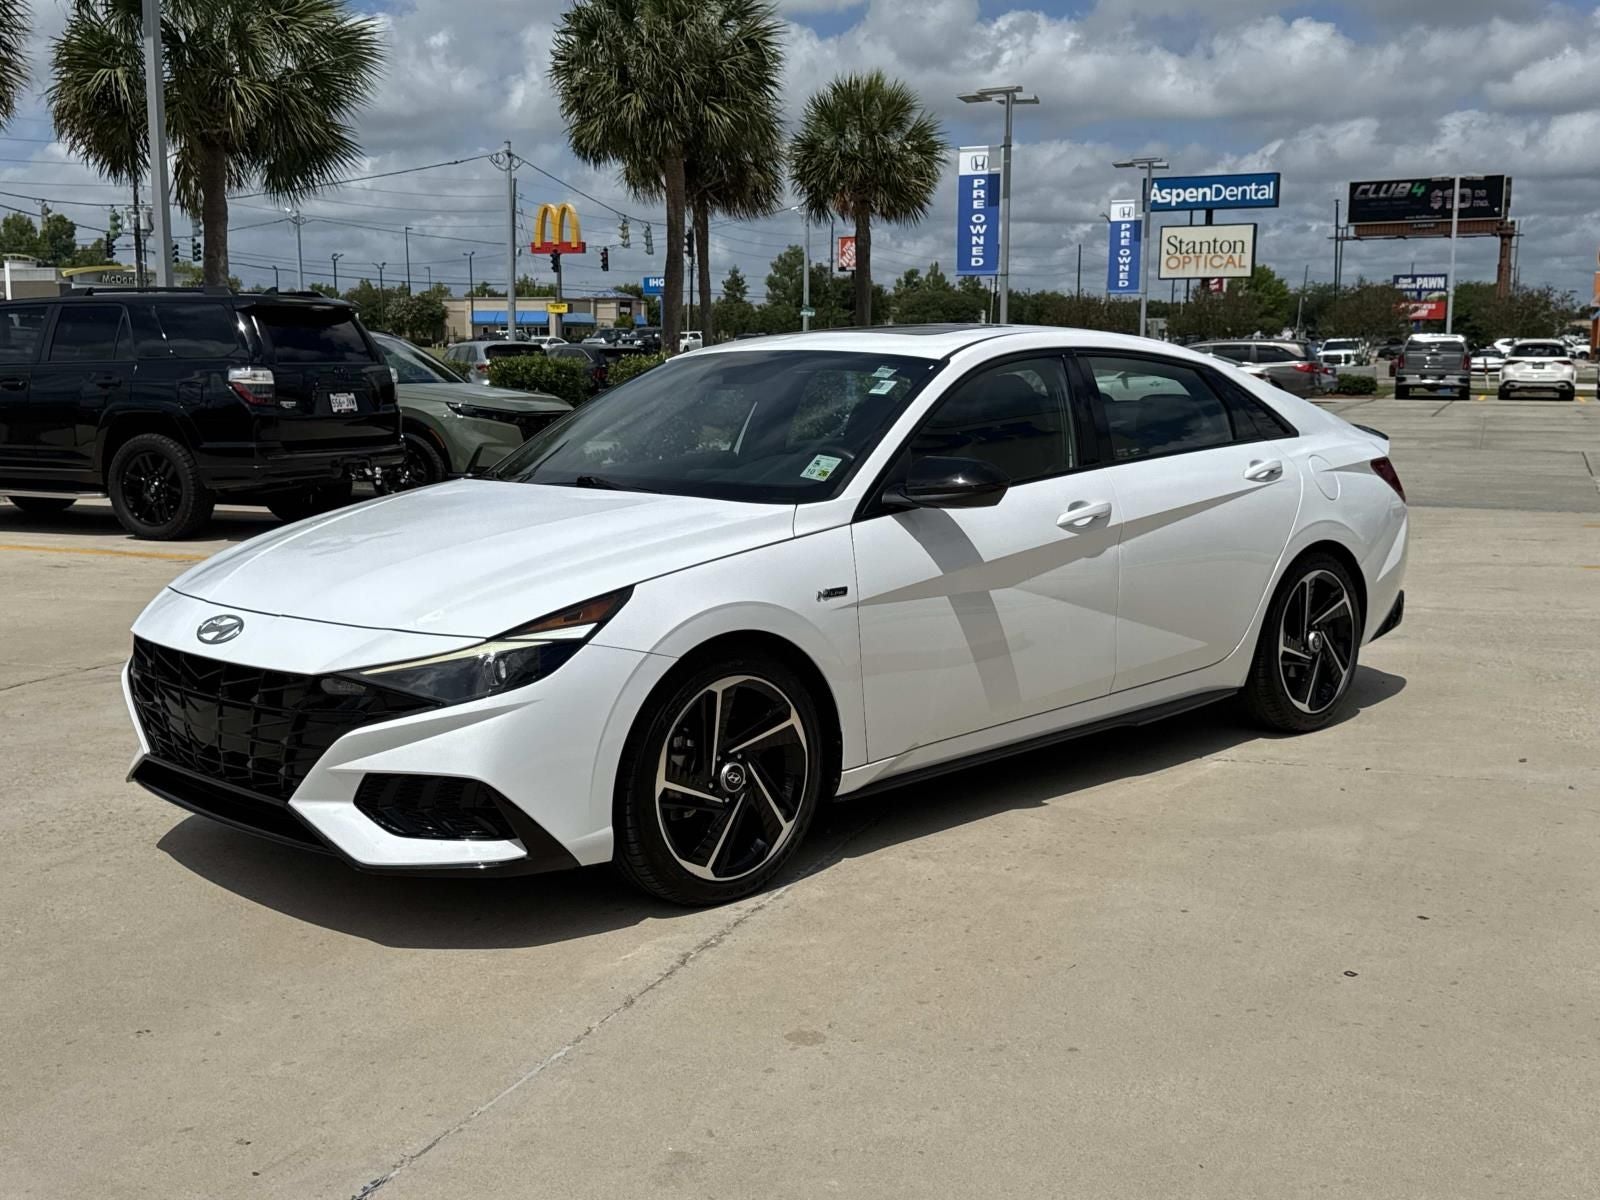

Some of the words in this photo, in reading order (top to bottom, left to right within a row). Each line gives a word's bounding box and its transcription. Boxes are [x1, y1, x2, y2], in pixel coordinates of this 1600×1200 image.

[972, 178, 986, 209] PRE
[969, 213, 988, 267] OWNED
[1120, 223, 1131, 246] PRE
[1166, 235, 1246, 256] Stanton
[1117, 248, 1132, 287] OWNED
[1166, 254, 1247, 270] OPTICAL
[648, 278, 665, 288] IHO
[1416, 277, 1445, 289] PAWN
